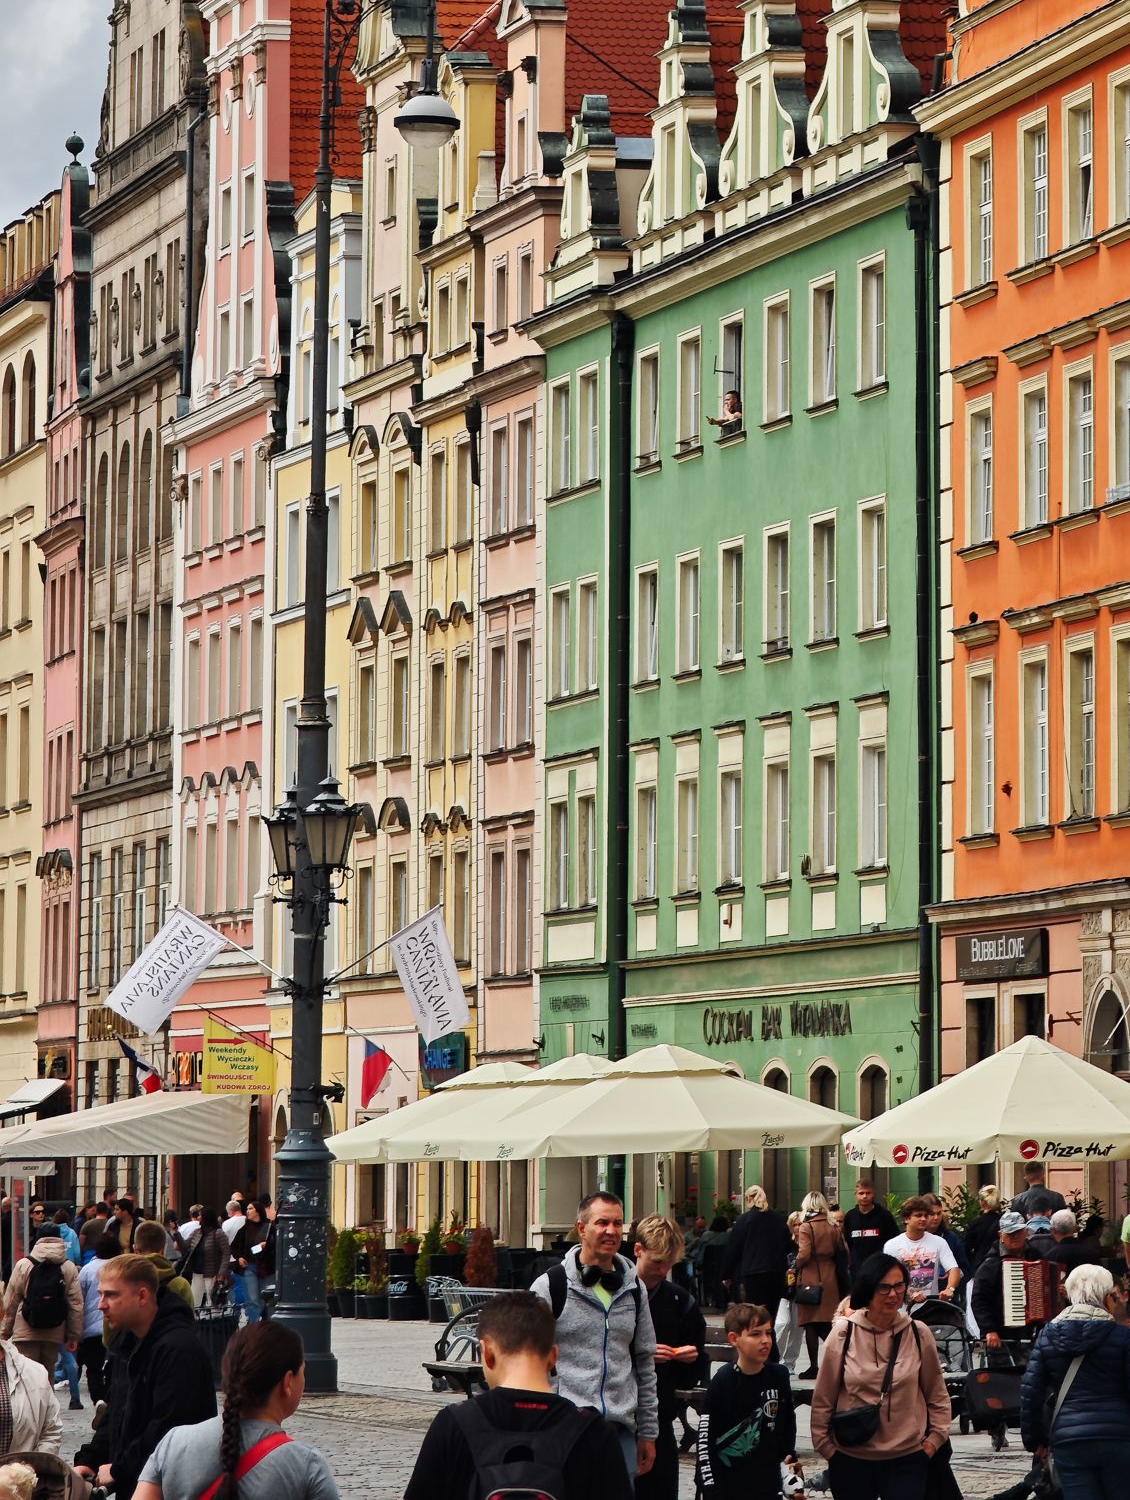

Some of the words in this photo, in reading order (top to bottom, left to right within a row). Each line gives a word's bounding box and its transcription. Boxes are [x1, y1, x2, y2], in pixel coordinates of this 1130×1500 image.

[208, 1046, 247, 1055] Weekendy
[217, 1055, 255, 1064] Wycieczki
[230, 1063, 259, 1072] Wczasy
[911, 1145, 946, 1162] Pizza
[947, 1145, 974, 1160] Hut
[1043, 1141, 1083, 1157] Pizza
[1084, 1141, 1118, 1157] Hut
